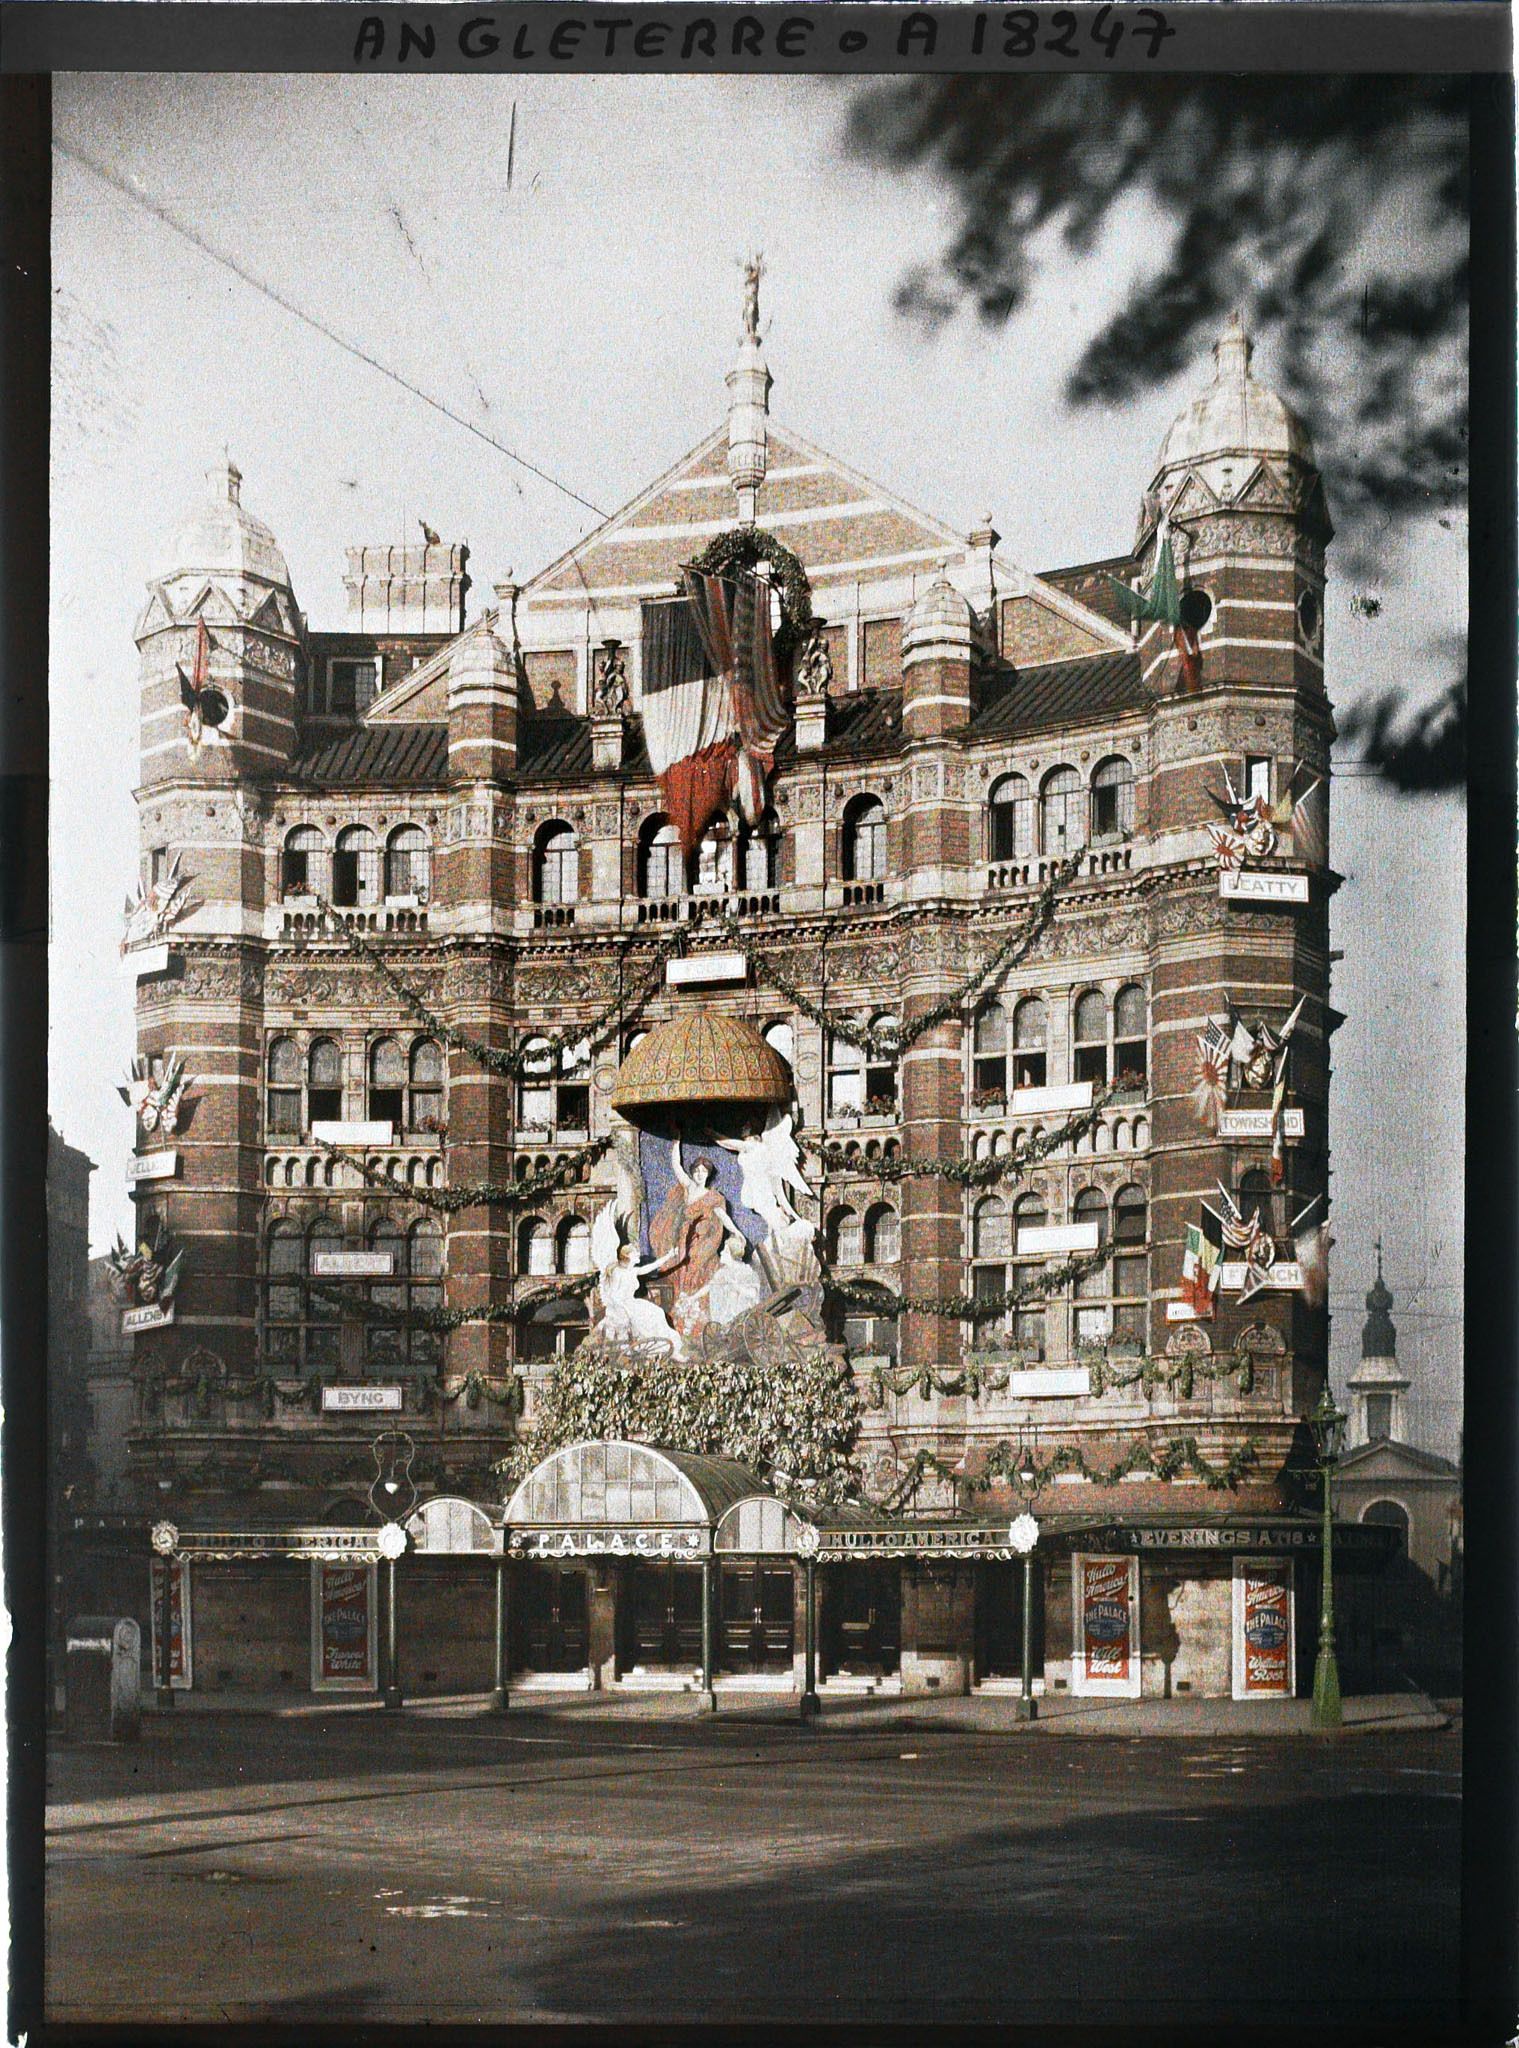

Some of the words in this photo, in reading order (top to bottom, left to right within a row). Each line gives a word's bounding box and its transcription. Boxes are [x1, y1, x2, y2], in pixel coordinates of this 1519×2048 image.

[1222, 1115, 1299, 1130] TOWNSHND
[1228, 1268, 1299, 1283] FNCH
[126, 1309, 167, 1325] ALLENB
[337, 1391, 384, 1405] BYNG
[275, 1536, 364, 1548] AMERICA
[538, 1533, 673, 1549] PALACE
[831, 1533, 898, 1547] HULLO
[904, 1533, 993, 1547] AMERICA
[1140, 1529, 1251, 1547] EVENINGS
